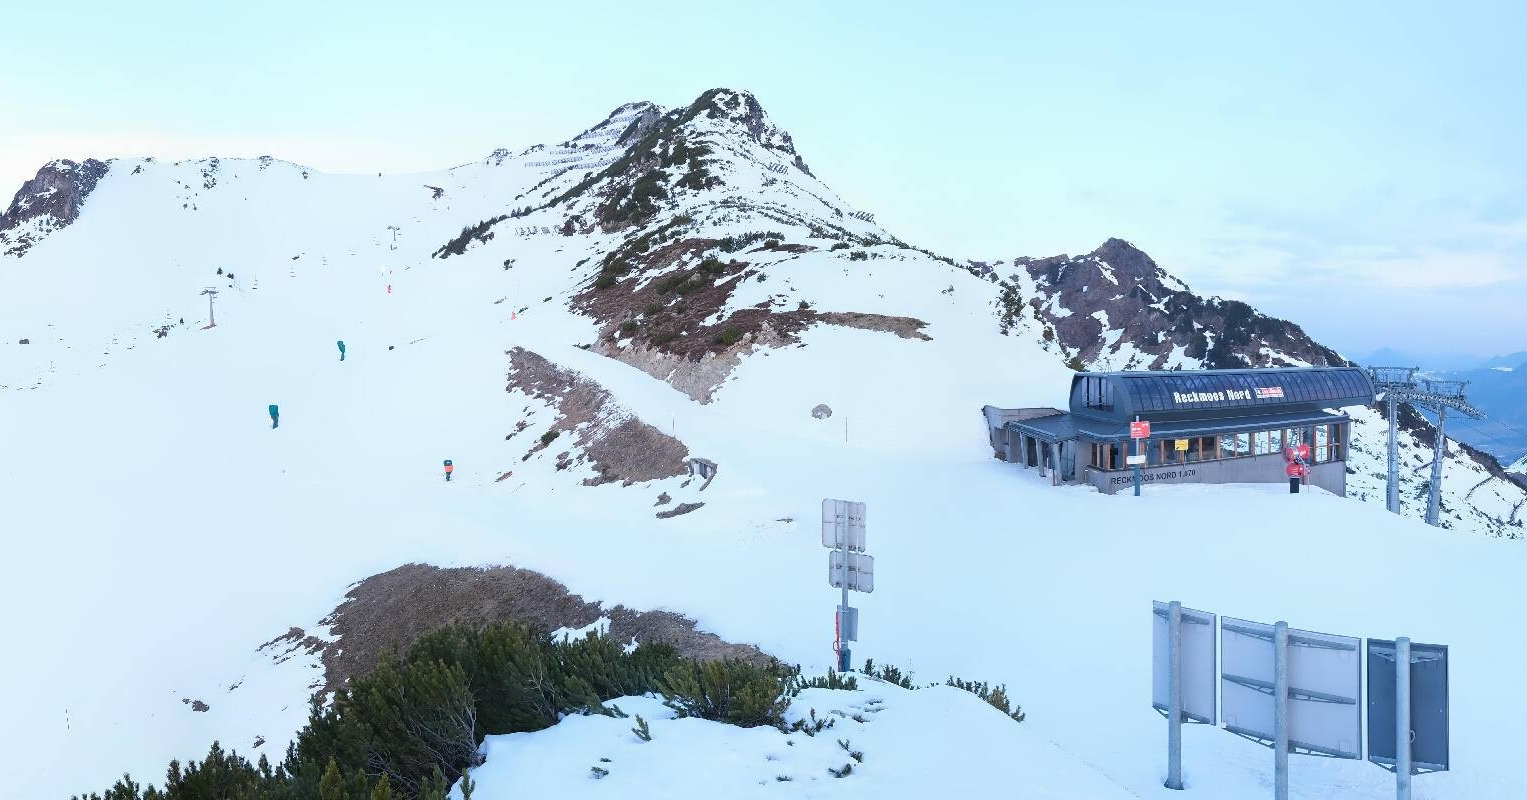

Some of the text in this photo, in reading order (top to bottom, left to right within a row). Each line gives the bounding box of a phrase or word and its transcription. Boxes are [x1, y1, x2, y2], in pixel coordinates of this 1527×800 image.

[1173, 391, 1225, 403] Reckmoos
[1226, 389, 1252, 401] Nord
[1110, 473, 1155, 485] RECKOOS
[1156, 471, 1177, 480] NORD
